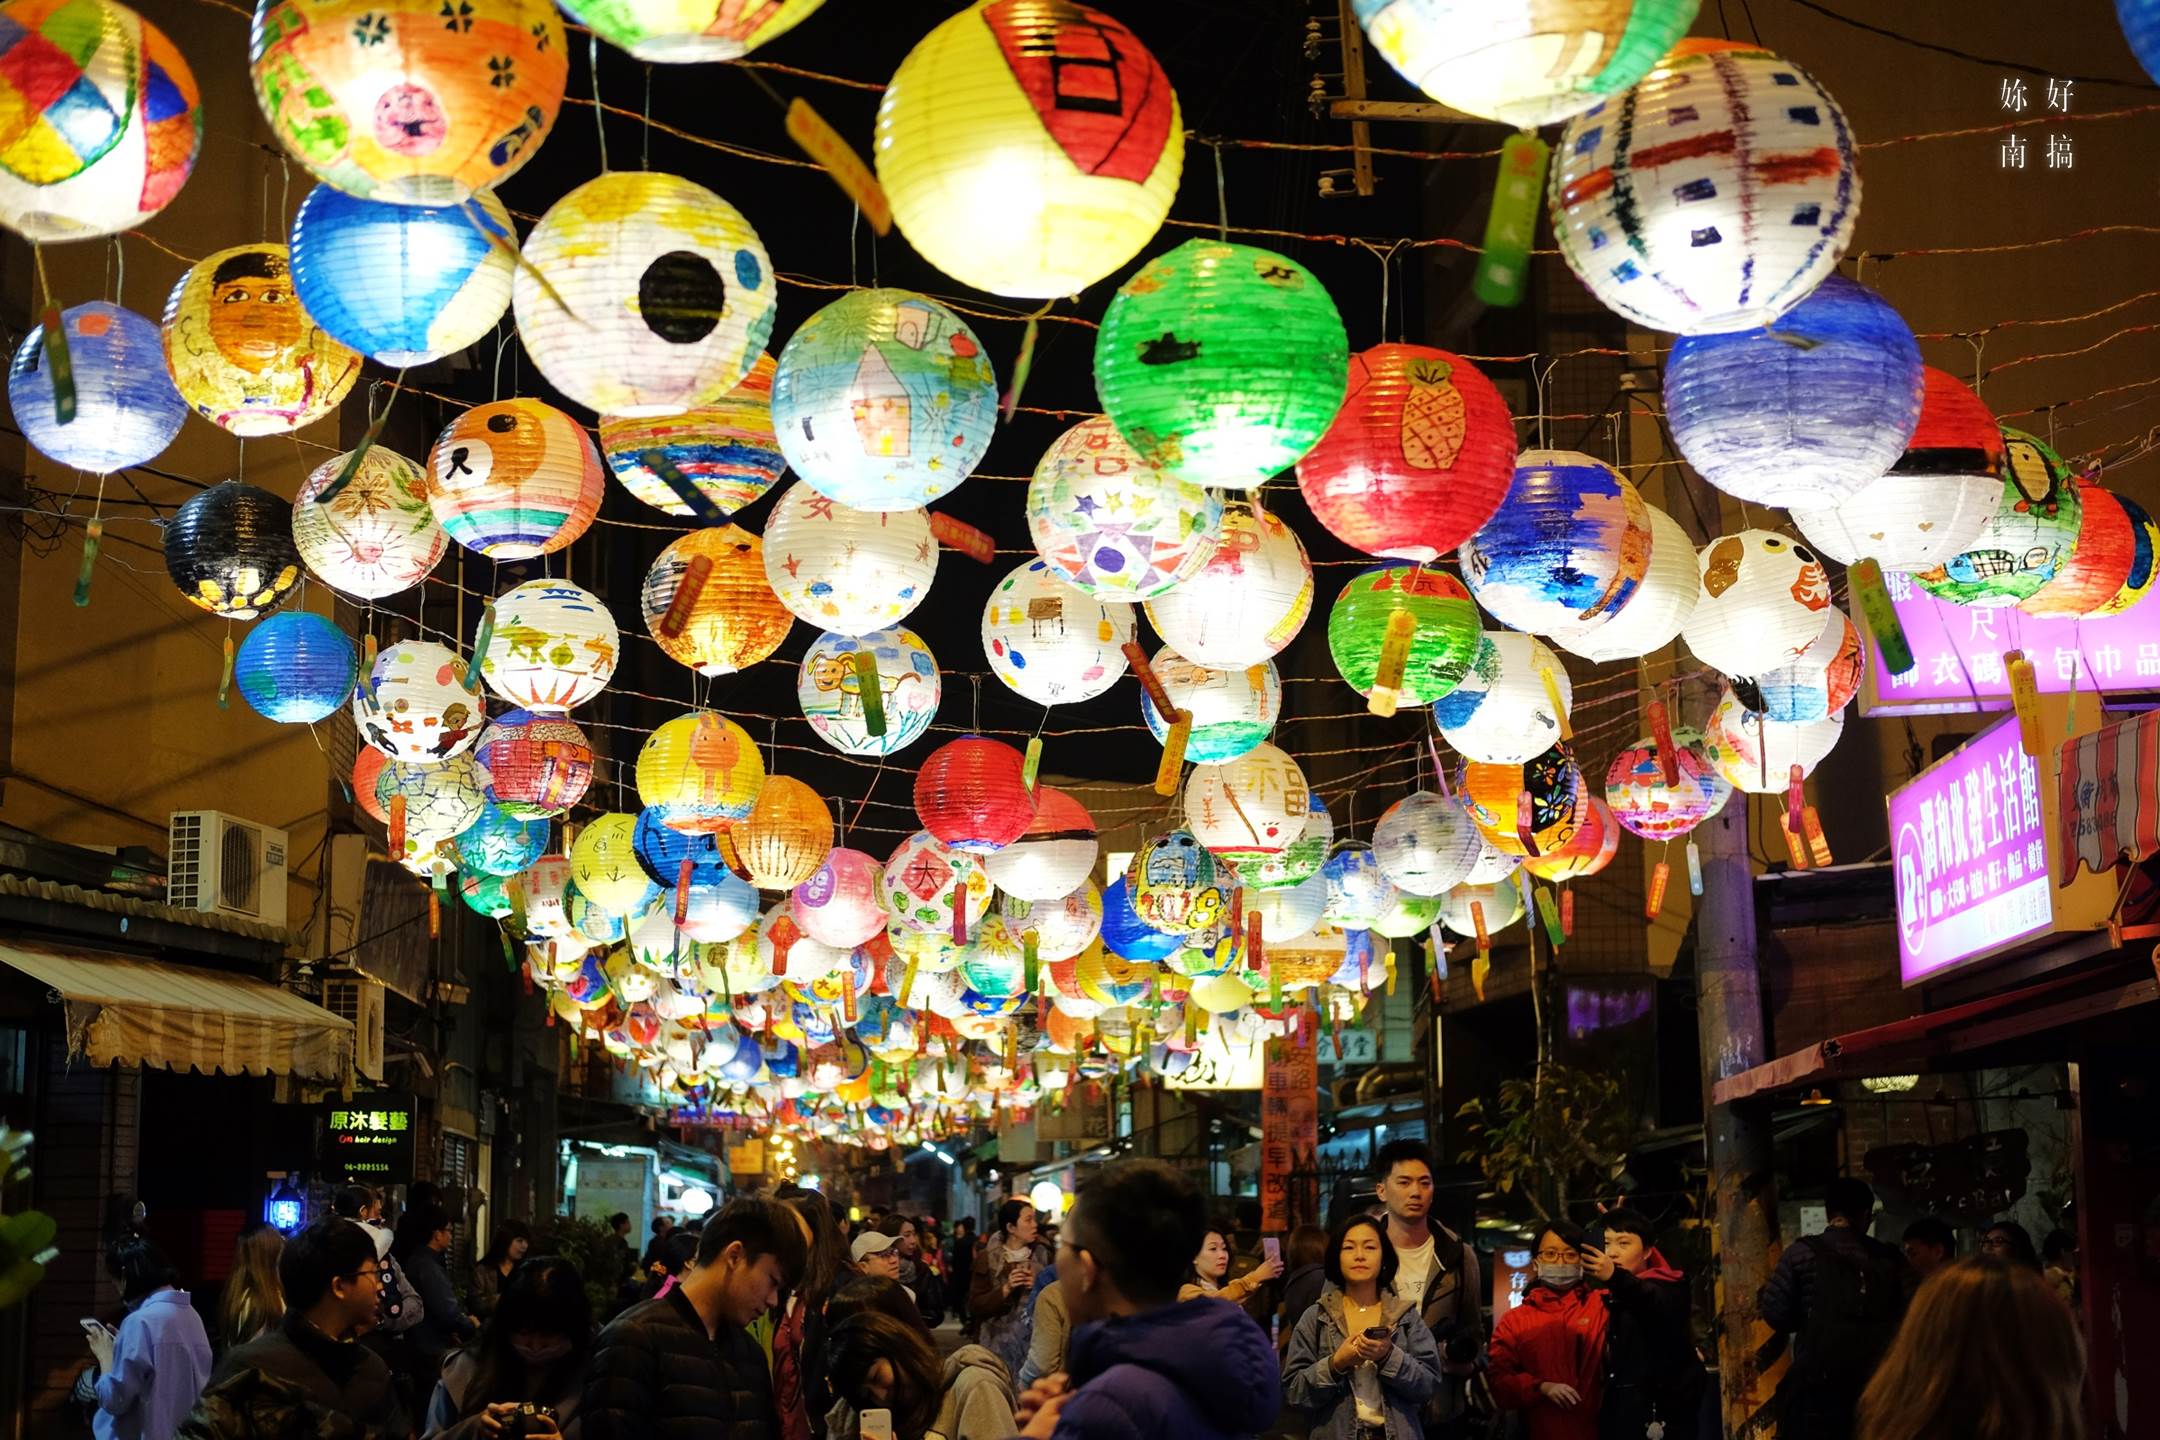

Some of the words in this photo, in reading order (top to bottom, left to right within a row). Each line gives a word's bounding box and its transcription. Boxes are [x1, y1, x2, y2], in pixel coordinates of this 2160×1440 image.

[913, 859, 940, 890] 大
[329, 1111, 409, 1130] 原沐髮藝
